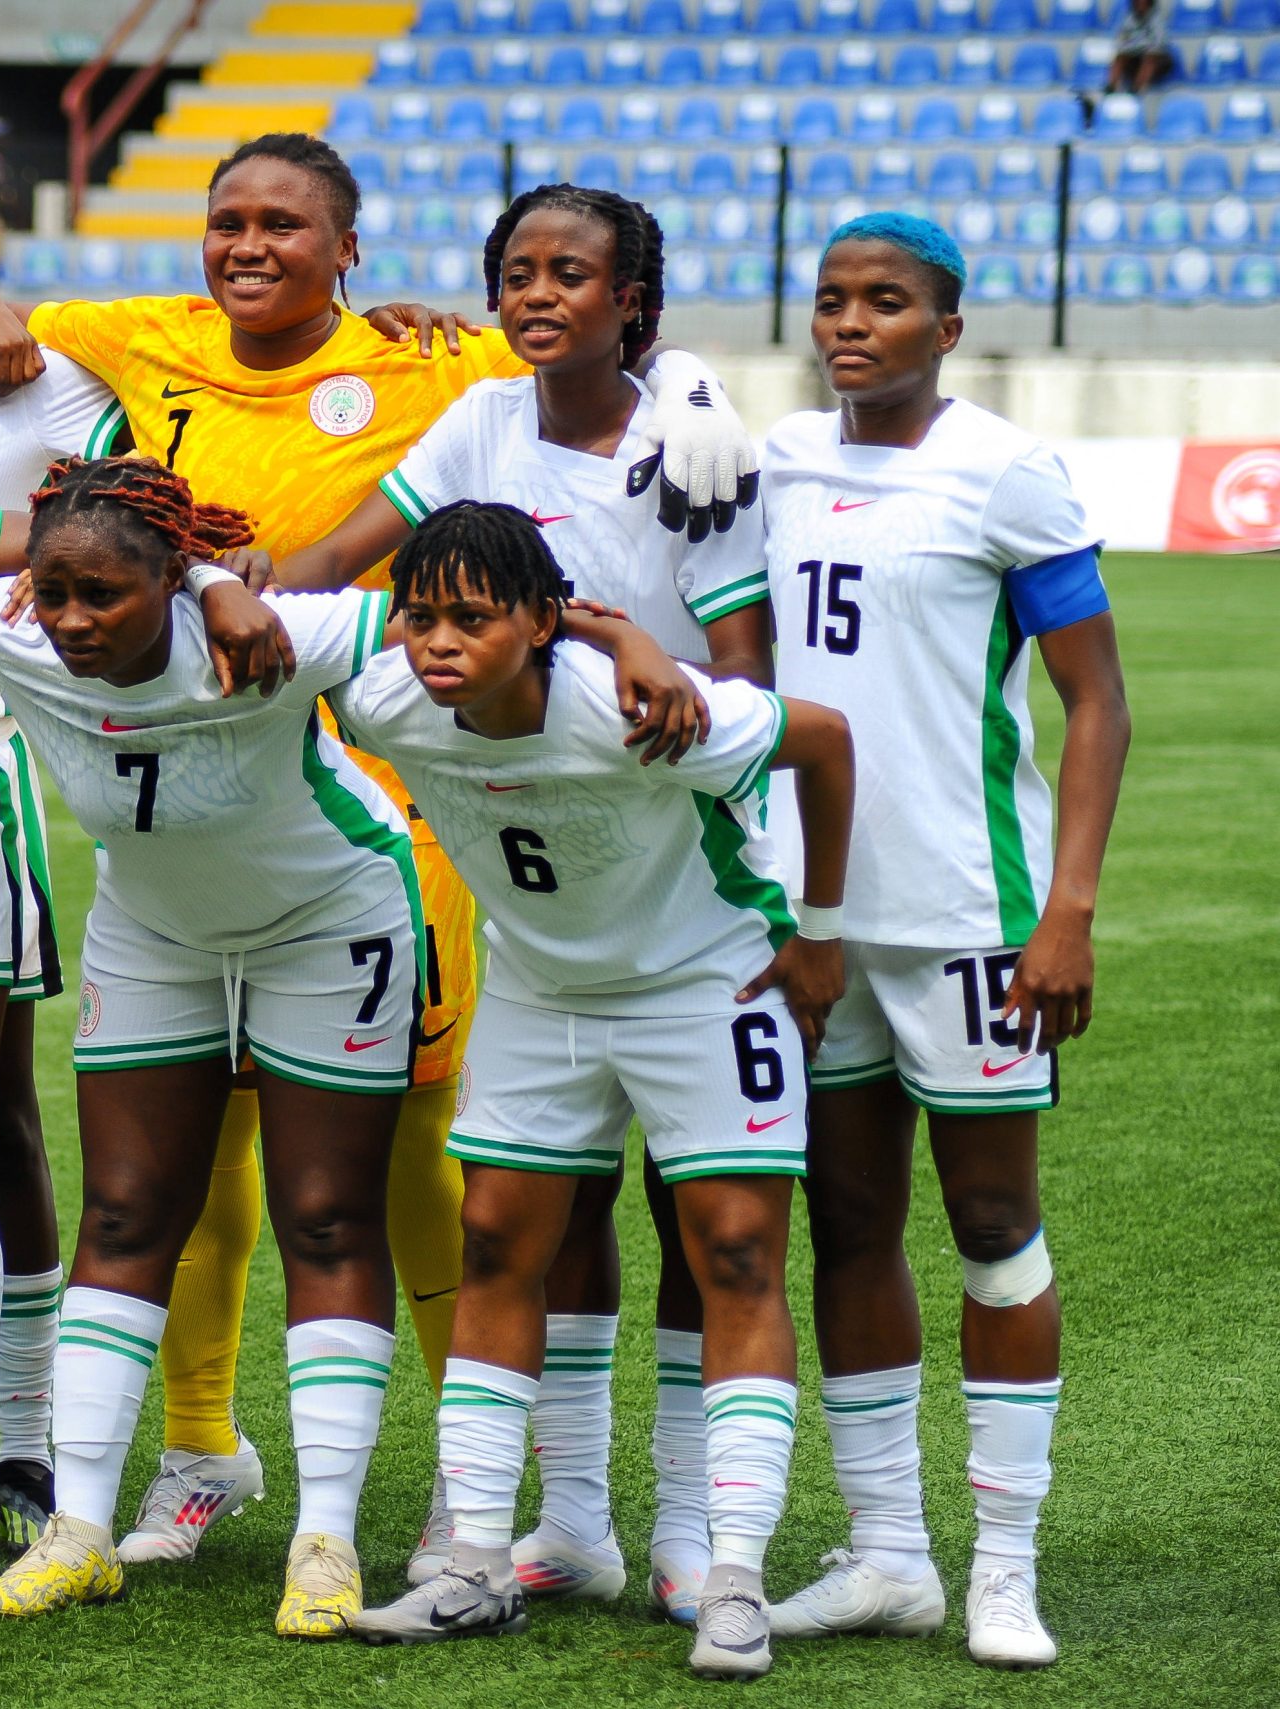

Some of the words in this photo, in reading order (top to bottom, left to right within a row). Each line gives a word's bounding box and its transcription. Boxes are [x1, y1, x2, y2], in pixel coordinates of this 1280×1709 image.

[796, 558, 864, 656] 15
[114, 752, 161, 834] 7
[498, 823, 559, 894] 6
[348, 936, 394, 1024] 7
[943, 951, 1022, 1048] 15
[731, 1011, 785, 1103] 6
[199, 1479, 237, 1491] F50
